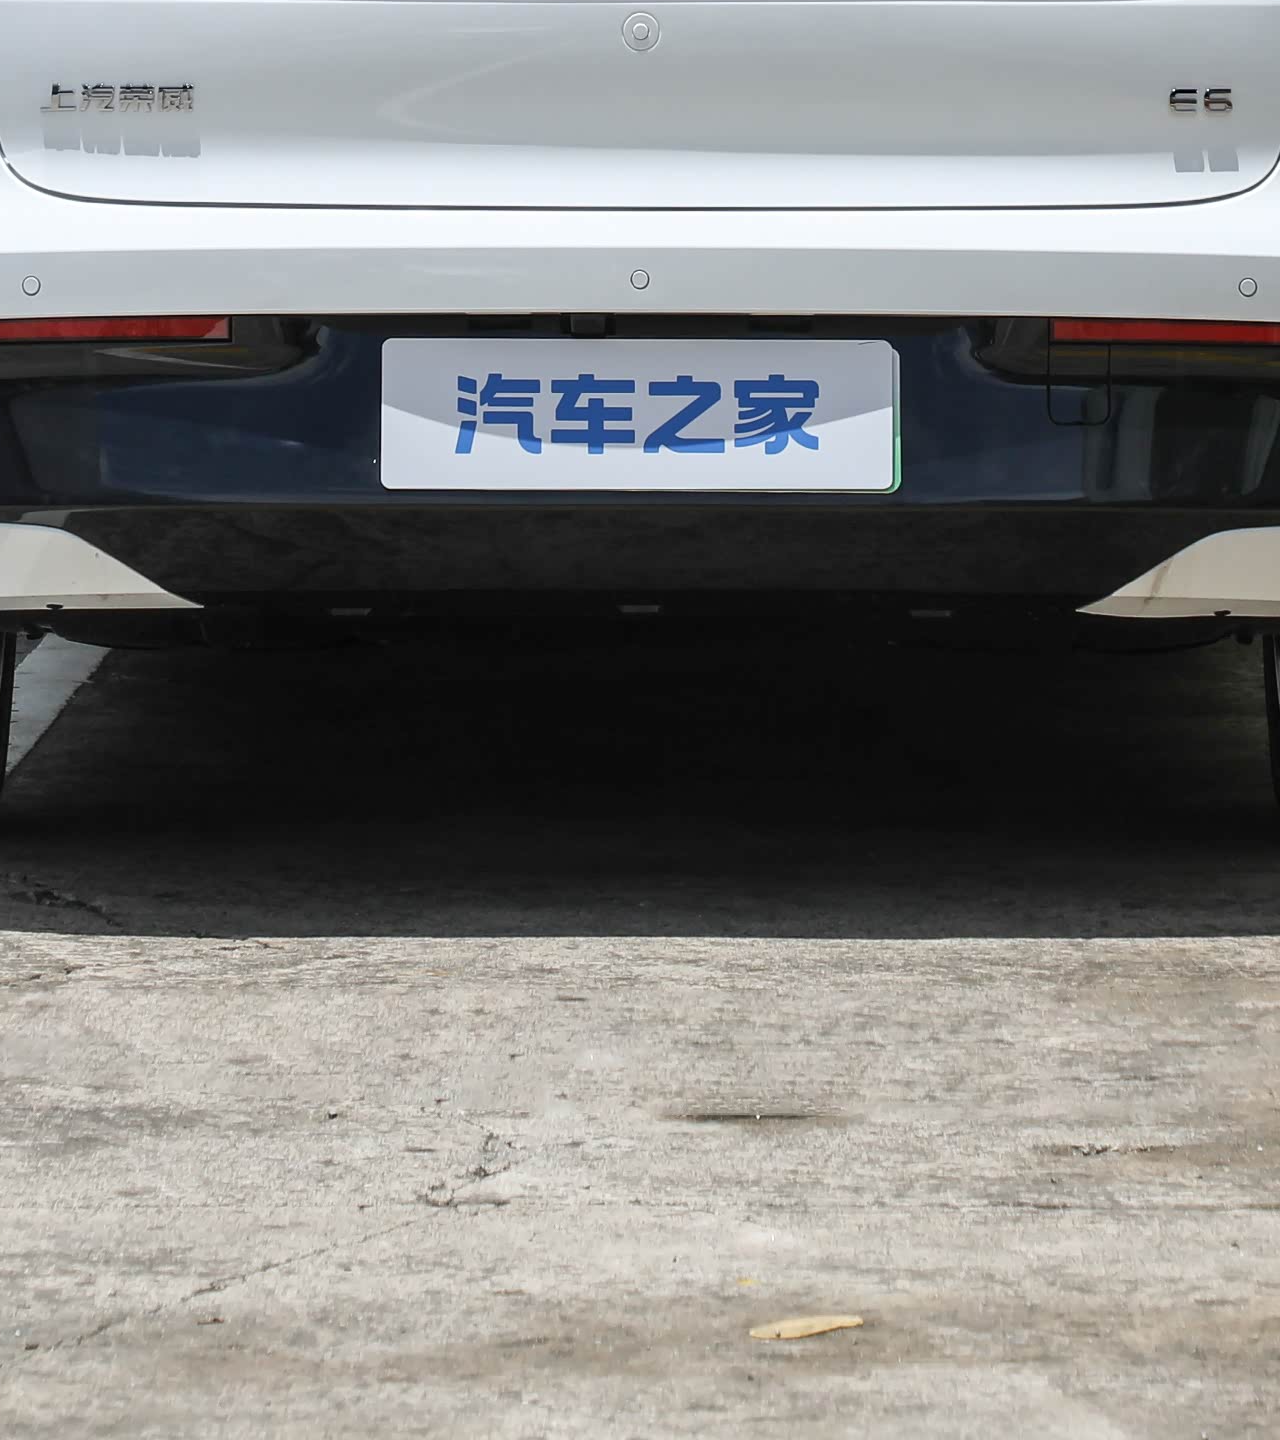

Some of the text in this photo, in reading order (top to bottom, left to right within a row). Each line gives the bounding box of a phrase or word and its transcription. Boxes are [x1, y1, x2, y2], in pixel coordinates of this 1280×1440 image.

[41, 82, 195, 113] 上汽荣威
[455, 373, 819, 454] 汽车之家
